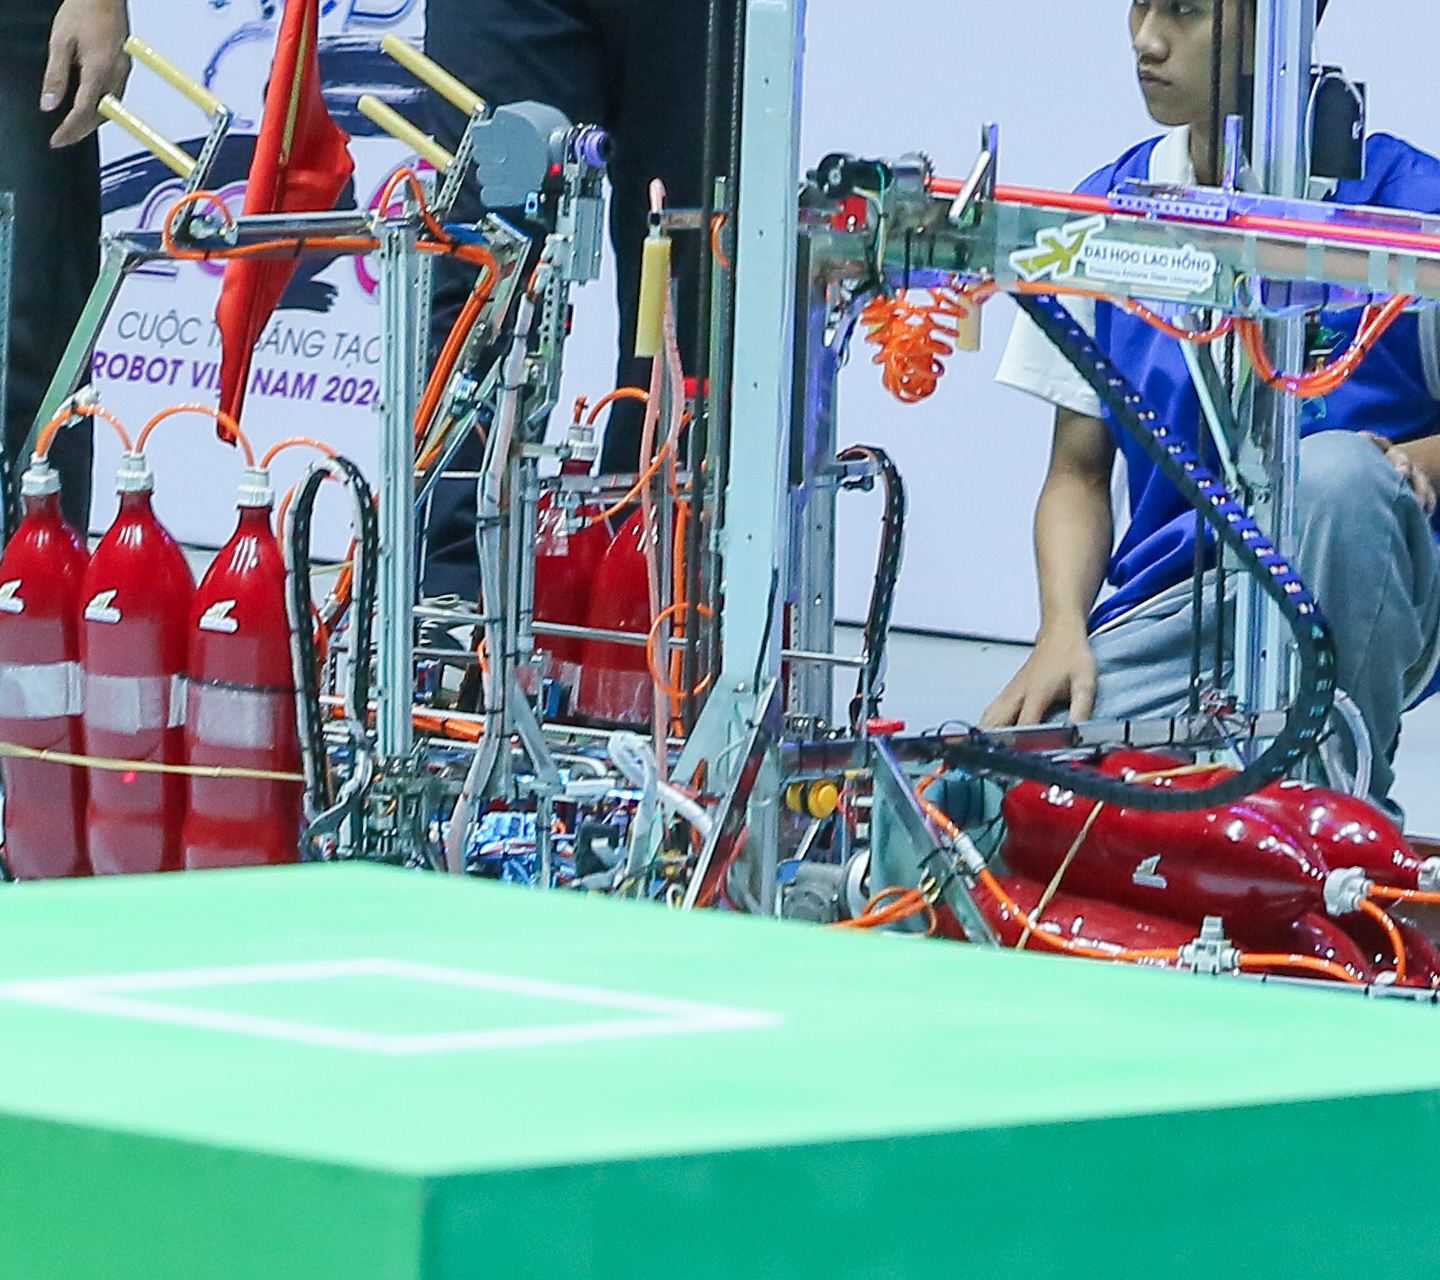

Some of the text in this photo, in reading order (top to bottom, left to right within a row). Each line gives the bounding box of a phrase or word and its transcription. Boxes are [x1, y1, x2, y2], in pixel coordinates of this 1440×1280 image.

[117, 310, 204, 350] CUỘC
[91, 351, 184, 388] ROBOT
[250, 368, 320, 401] NAM
[322, 375, 380, 406] 202
